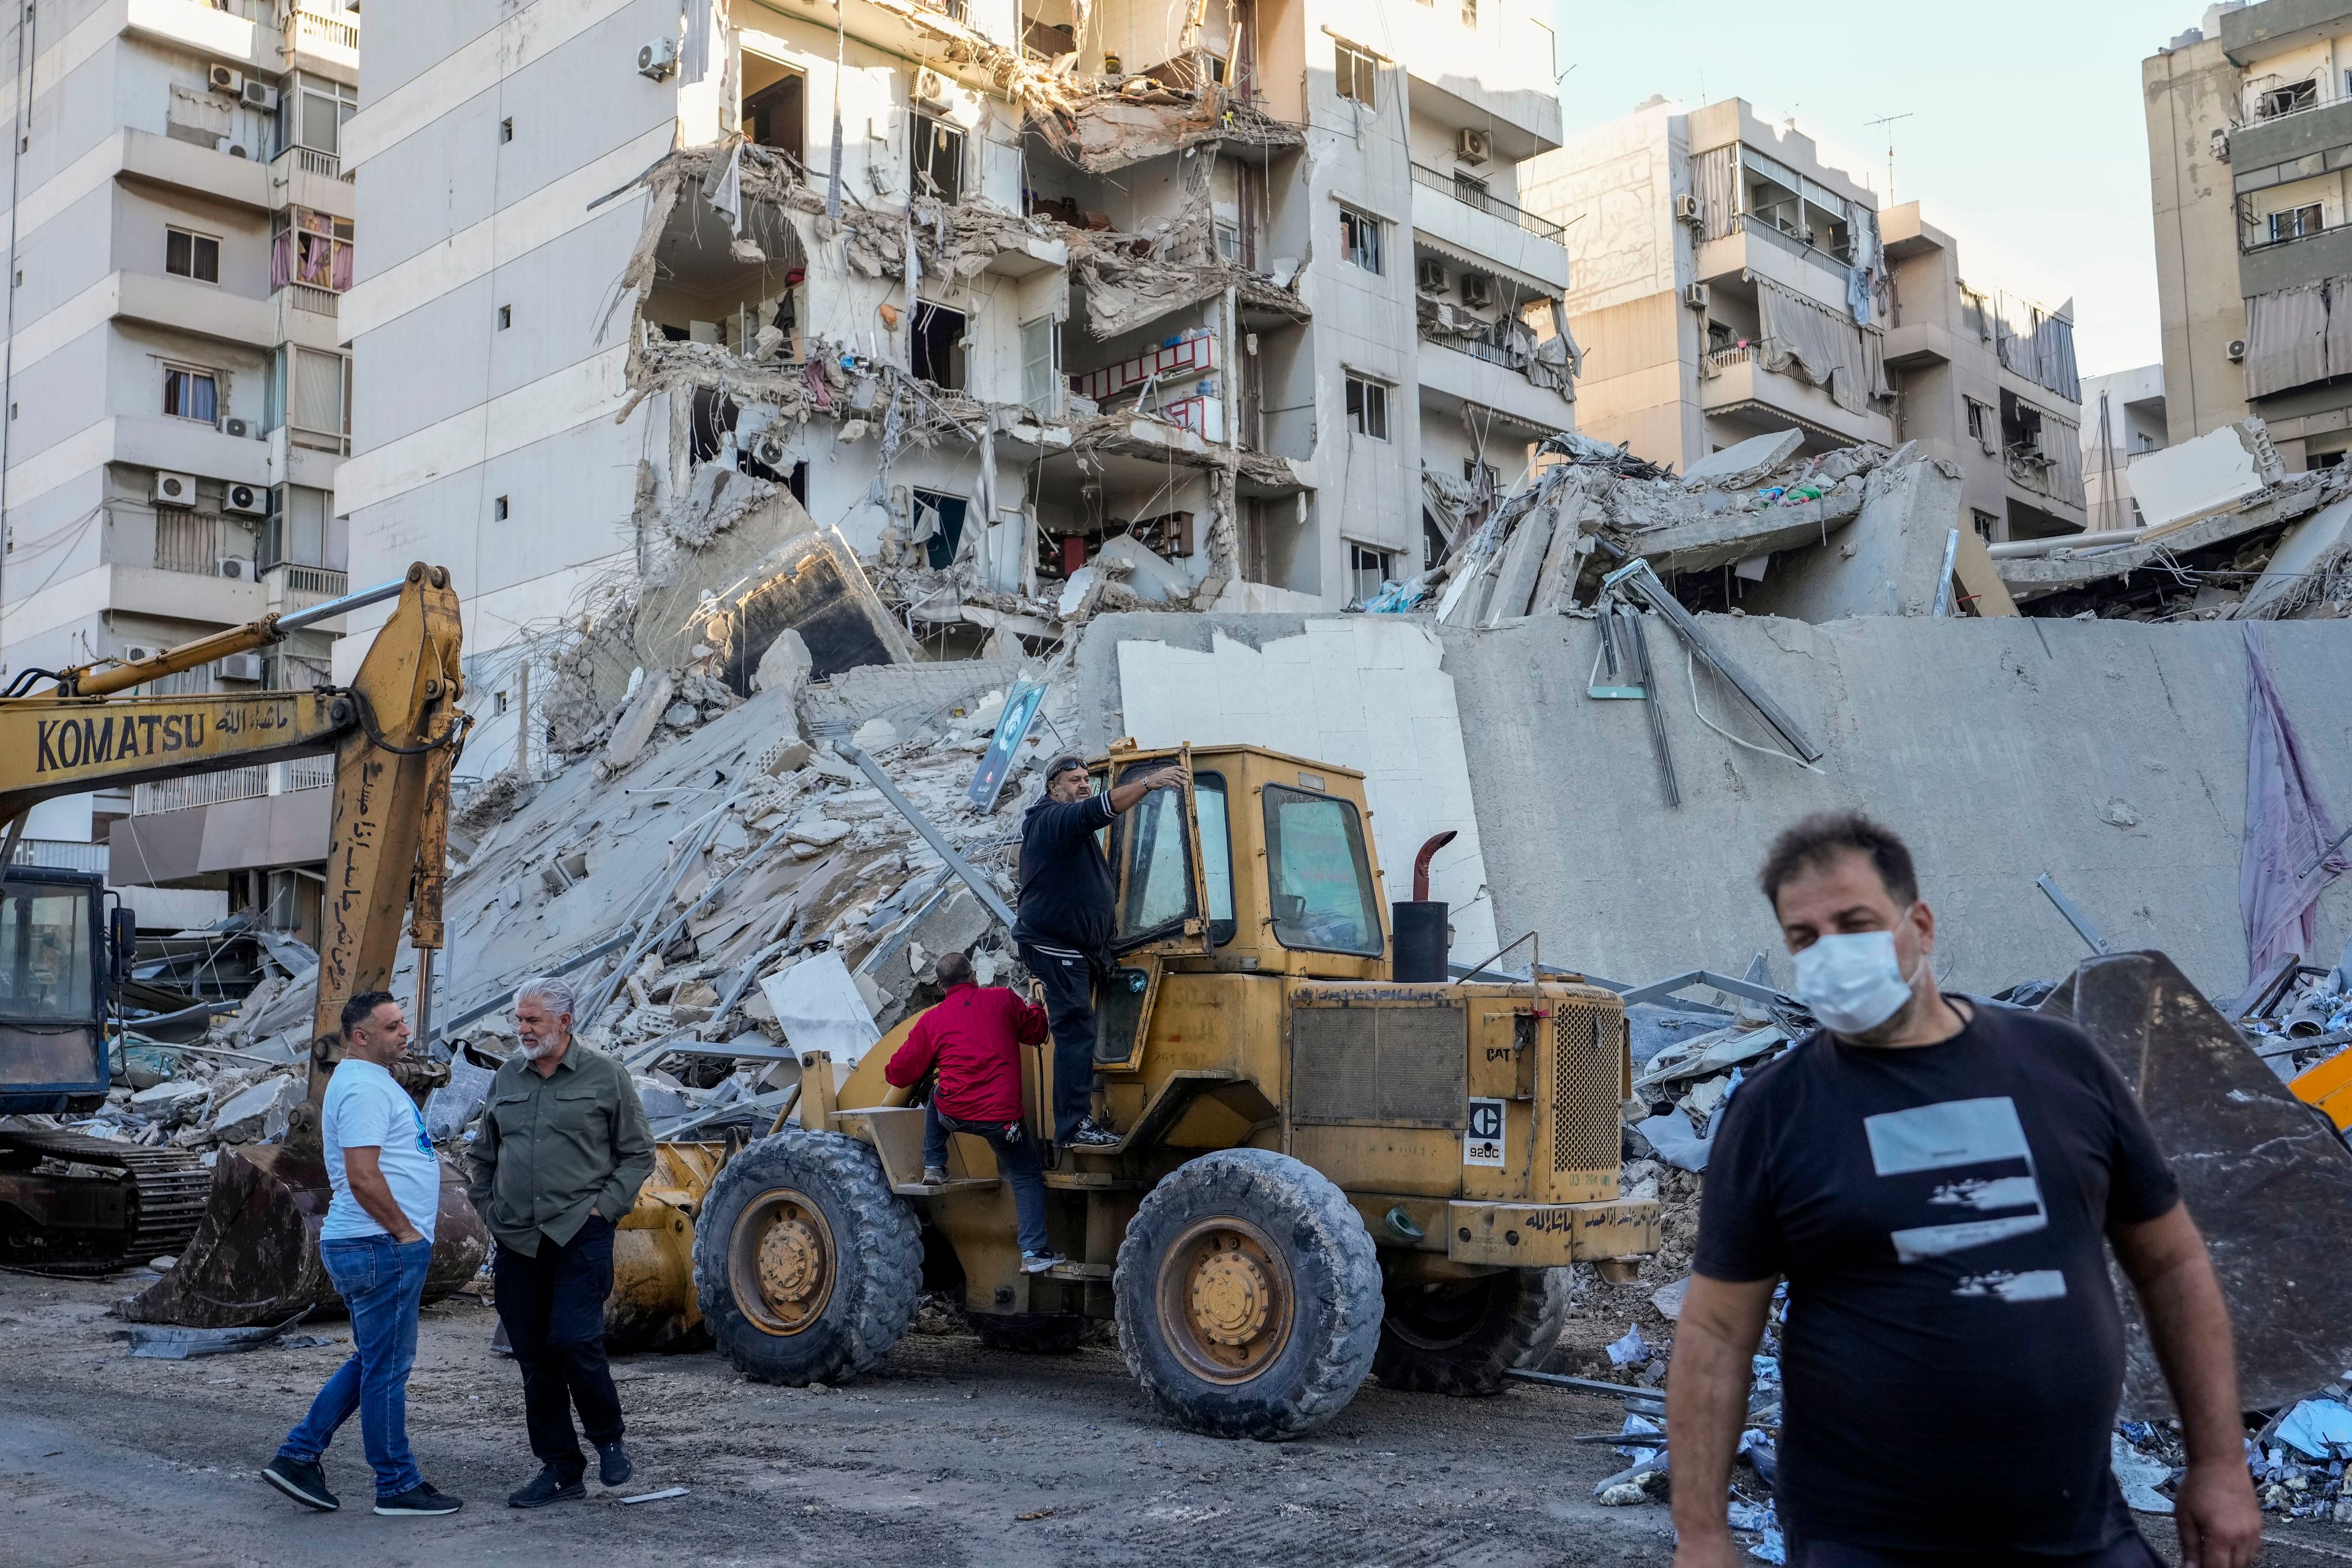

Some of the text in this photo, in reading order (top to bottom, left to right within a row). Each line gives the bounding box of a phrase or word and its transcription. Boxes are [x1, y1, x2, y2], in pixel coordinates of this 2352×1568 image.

[36, 713, 206, 773] KOMATSU
[1487, 1048, 1510, 1063] CAT
[1470, 1147, 1499, 1158] 920C
